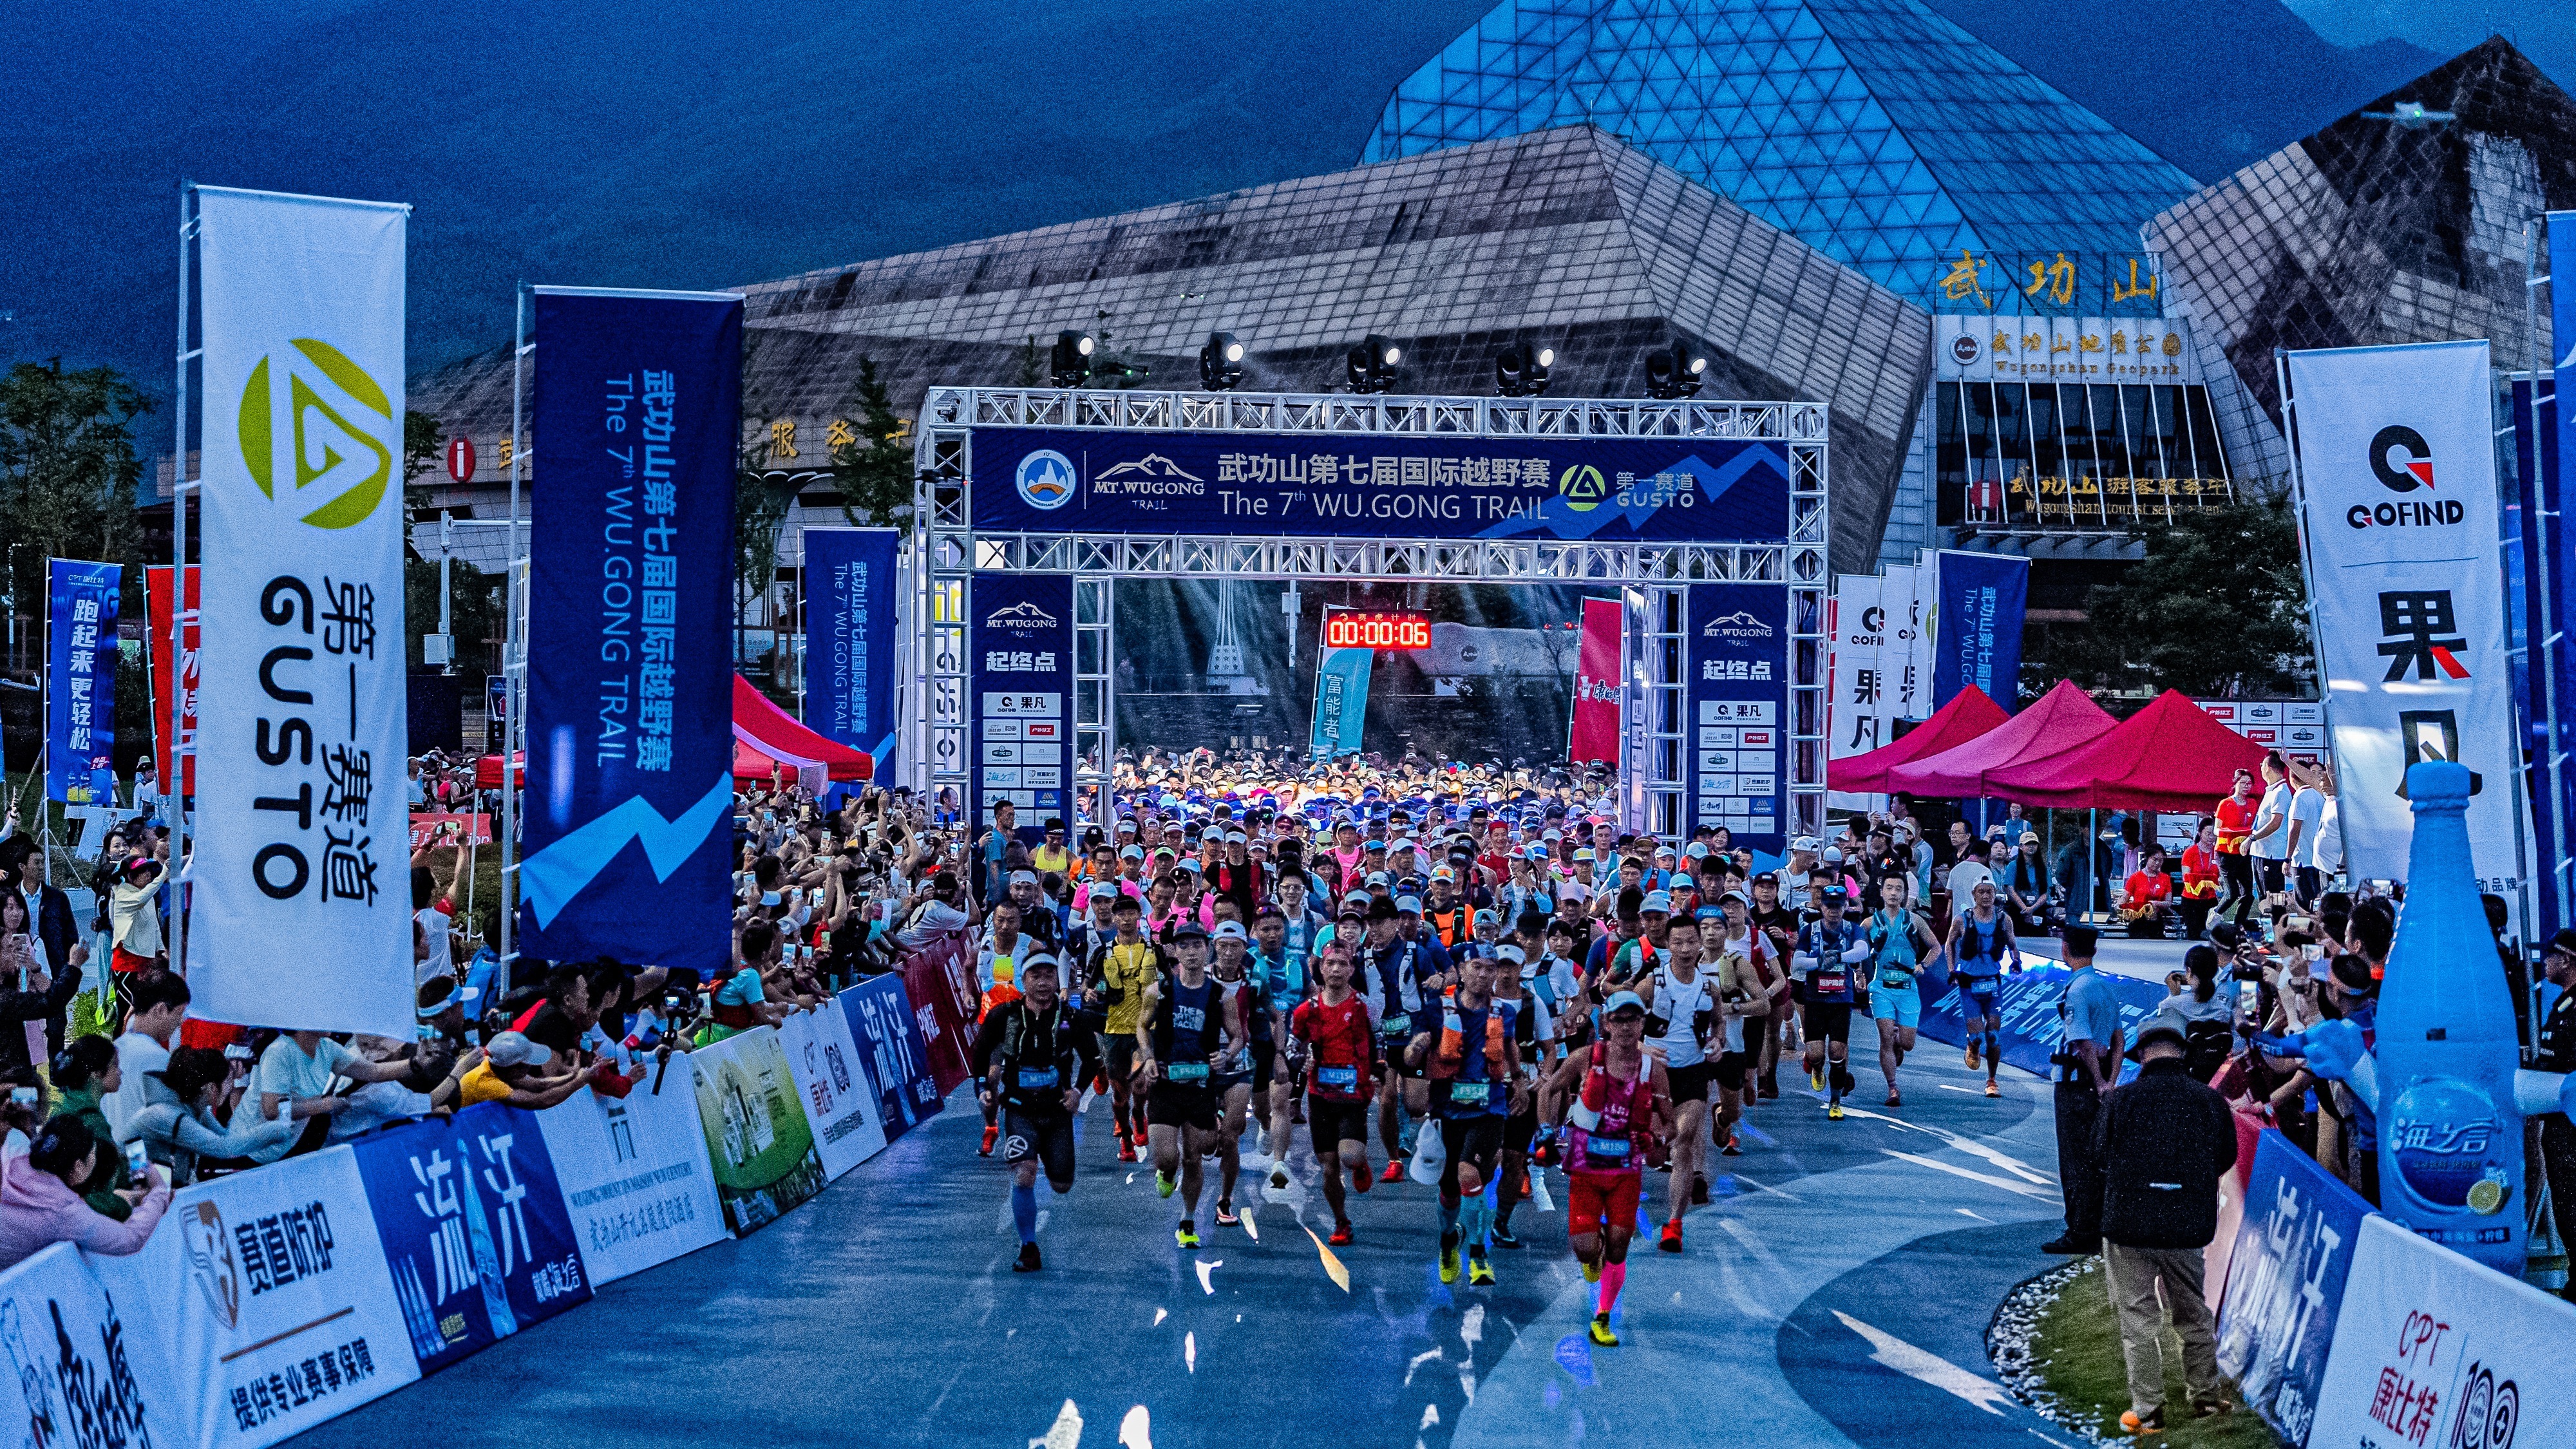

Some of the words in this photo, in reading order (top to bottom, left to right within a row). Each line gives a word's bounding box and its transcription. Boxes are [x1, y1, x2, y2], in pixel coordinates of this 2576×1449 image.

[1938, 248, 2158, 310] 武功山
[605, 373, 634, 433] The
[1217, 452, 1551, 488] 武功山第七届国际越野赛
[1616, 471, 1694, 493] 第一赛道
[1218, 490, 1269, 516] The
[1312, 491, 1461, 521] WU.GONG
[1470, 495, 1550, 520] TRAIL
[1616, 493, 1694, 509] GUSTO
[600, 486, 634, 663] WU.GONG
[636, 369, 677, 772] 武功山第七届国际越野赛
[834, 563, 848, 589] The
[851, 560, 867, 734] 武功山第七届国际越野赛
[986, 651, 1057, 672] 起终点
[1330, 621, 1428, 645] 00:00:06
[1976, 586, 1997, 695] 武功山第七届国
[1703, 659, 1772, 681] 起终点
[597, 674, 630, 768] TRAIL
[834, 692, 848, 734] TRAIL
[1020, 696, 1046, 709] 果凡
[1736, 705, 1762, 717] 果凡
[252, 575, 314, 900] GUSTO
[319, 575, 379, 908] 第一赛道
[2391, 1117, 2494, 1153] 海之言
[234, 1200, 334, 1296] 赛道防护
[2399, 1309, 2450, 1370] CPT
[229, 1336, 377, 1432] 提供专业赛事保障
[2369, 1366, 2439, 1448] 康比特
